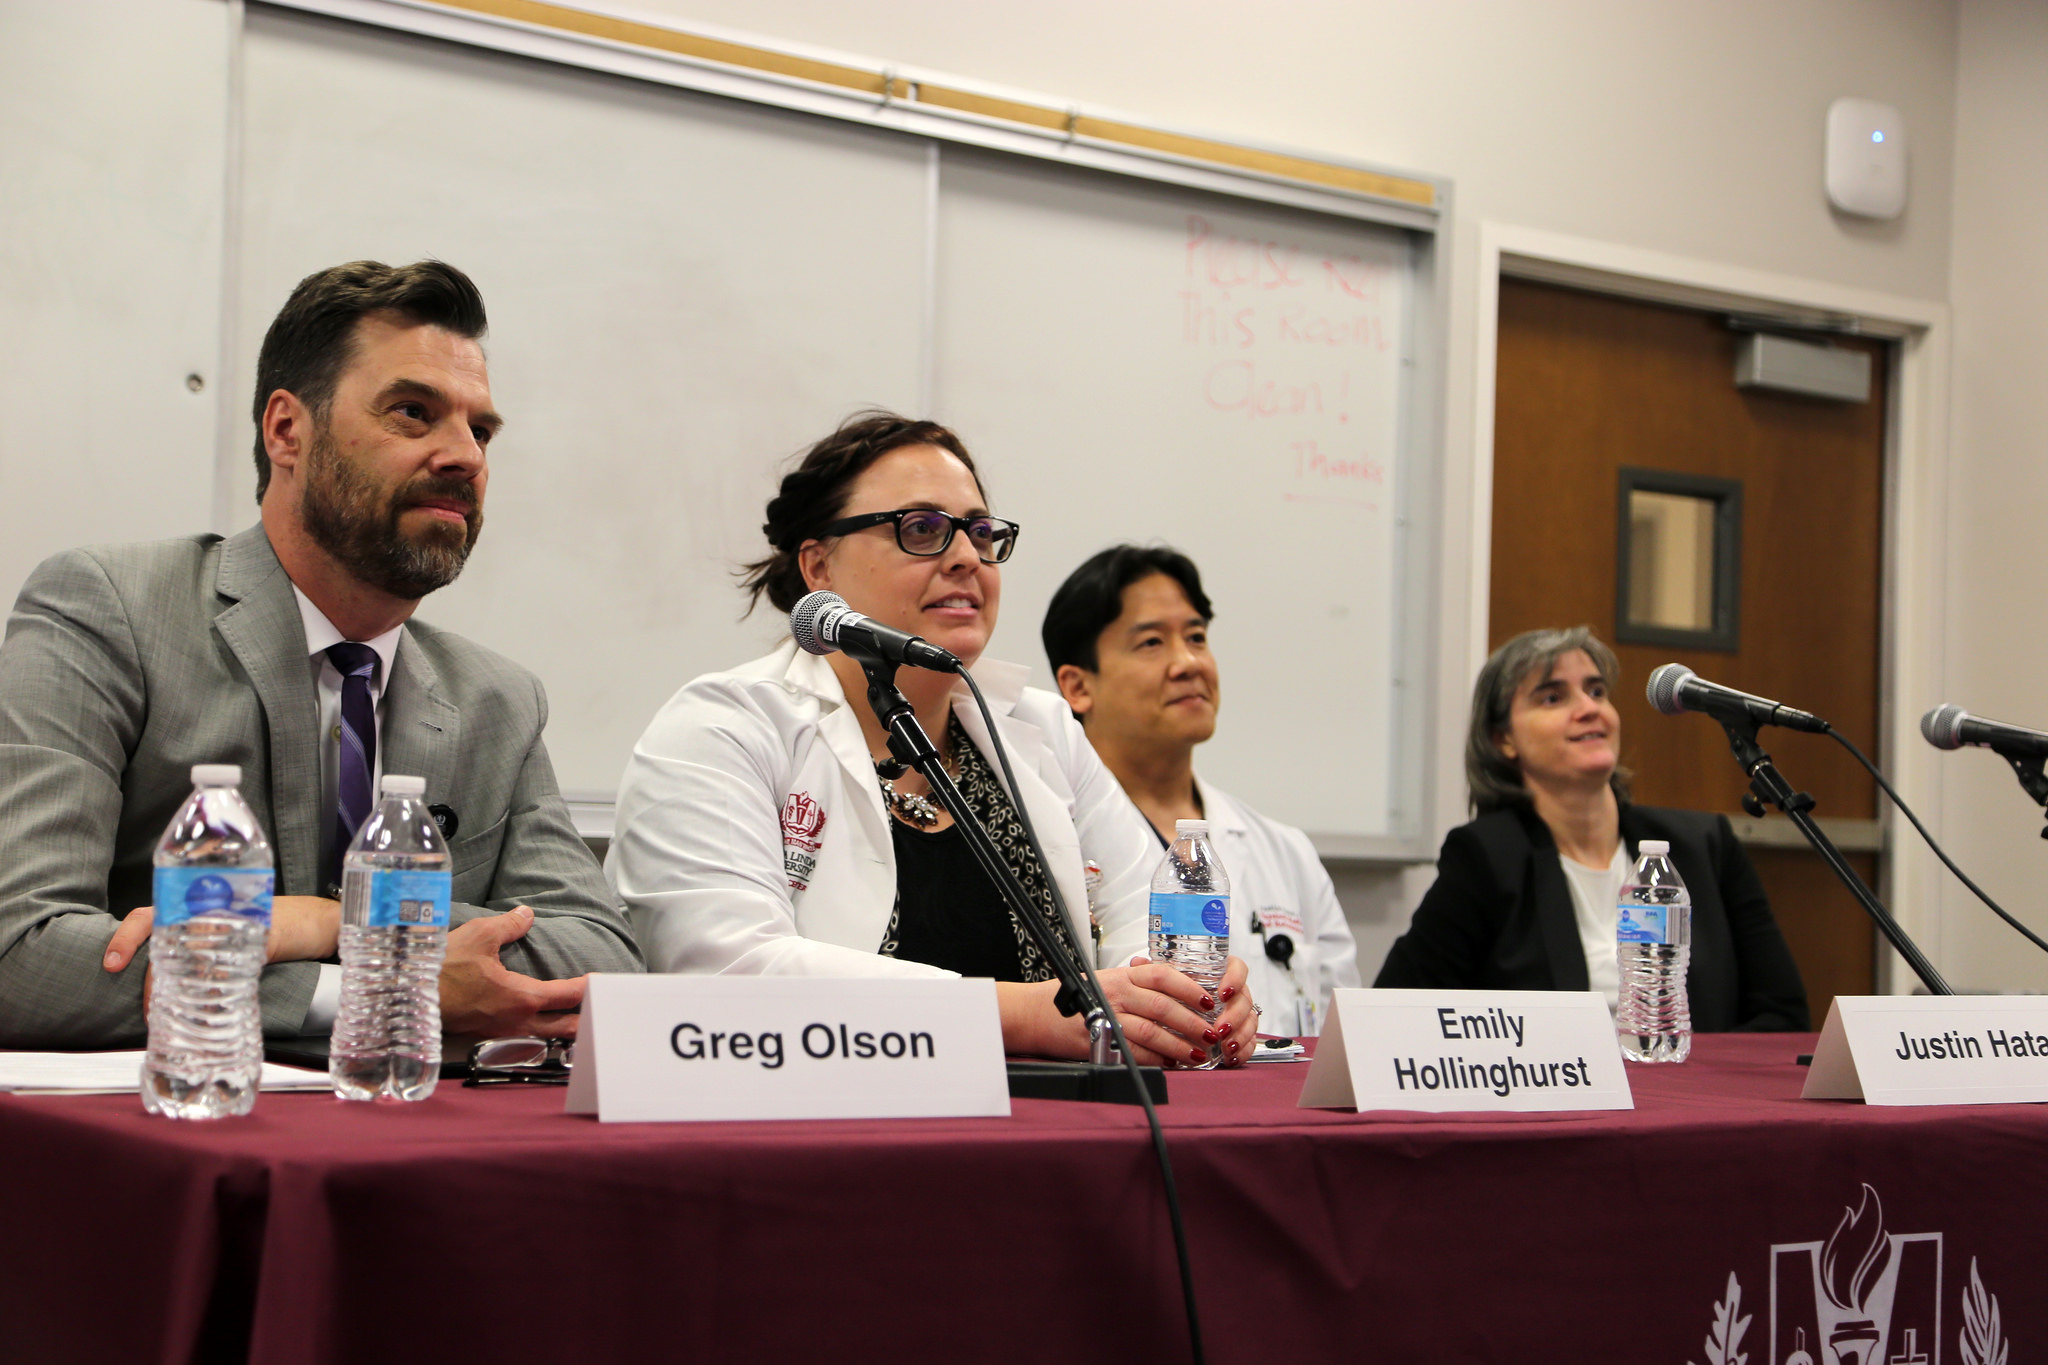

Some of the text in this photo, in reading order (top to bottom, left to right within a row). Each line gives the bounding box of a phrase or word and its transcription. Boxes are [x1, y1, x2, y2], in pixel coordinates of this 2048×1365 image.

[1178, 290, 1256, 349] This
[784, 860, 813, 876] ERSITY
[790, 851, 816, 869] LINDA
[669, 1022, 935, 1069] Greg Olson
[1437, 1007, 1524, 1047] Emily
[1895, 1029, 2048, 1060] Justin Hata
[1393, 1056, 1592, 1097] Hollinghurst
